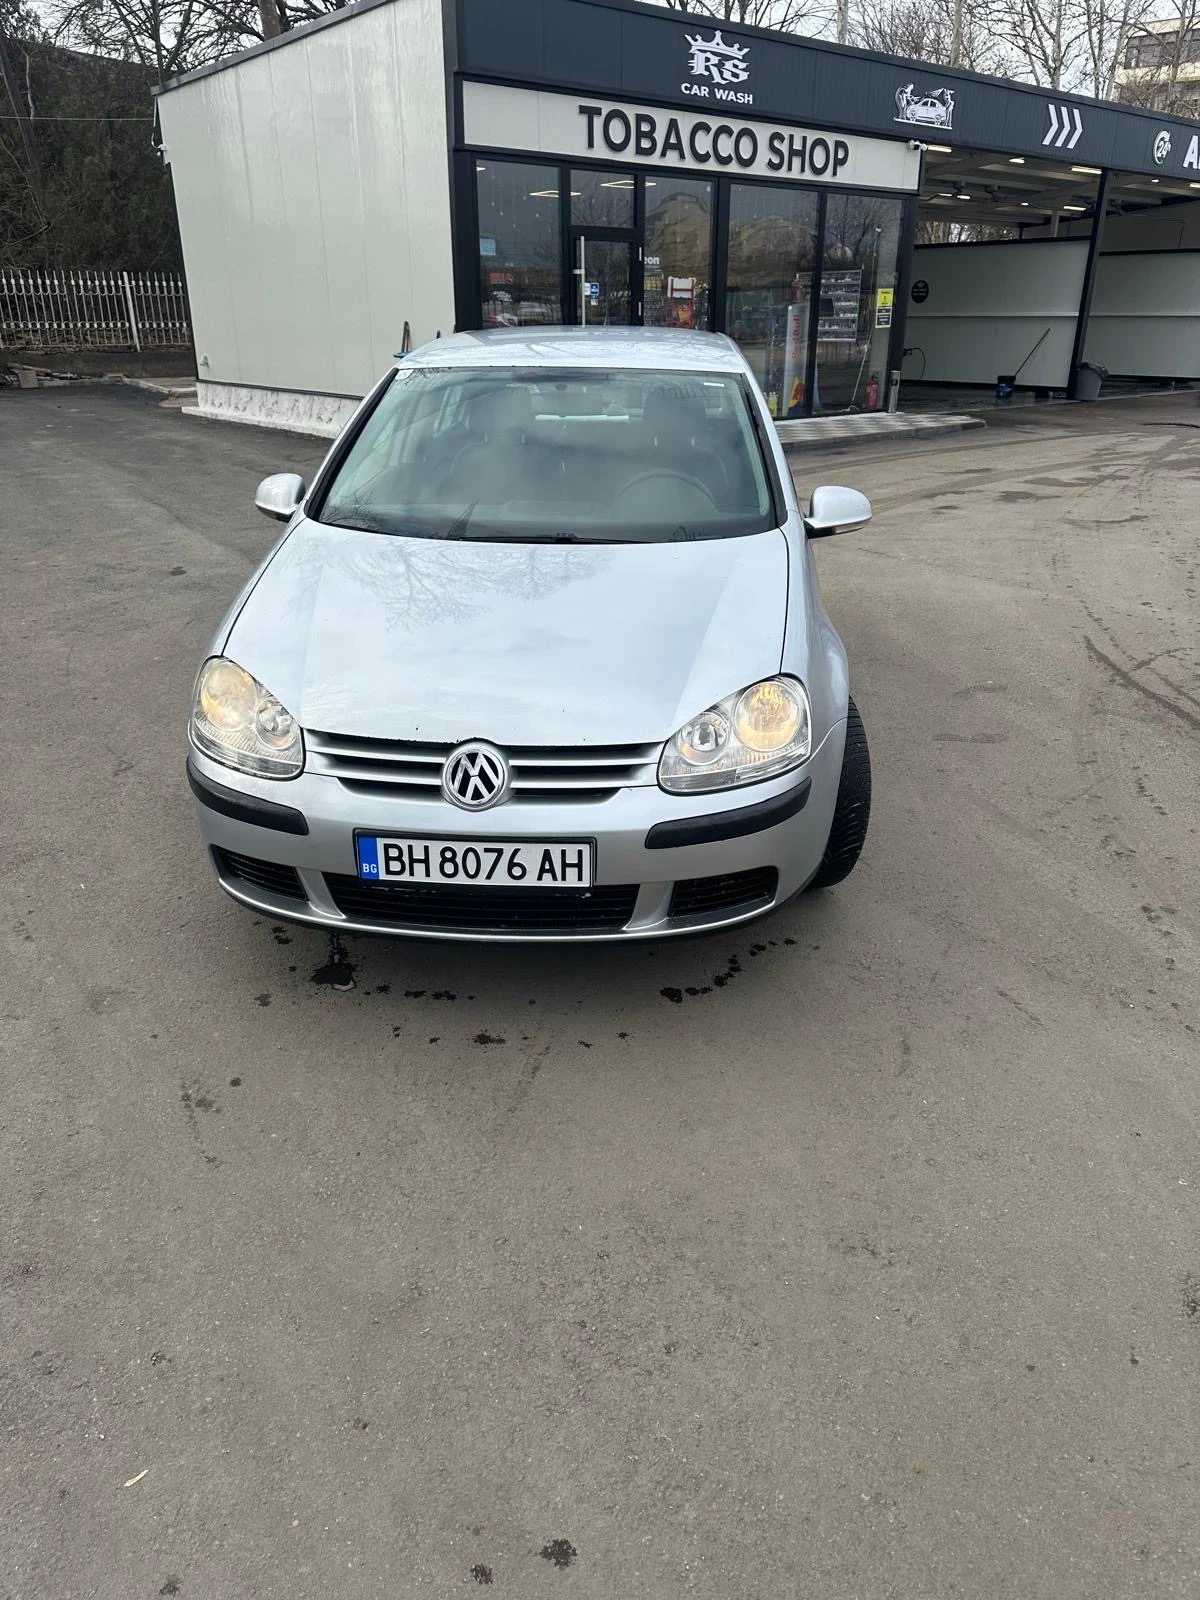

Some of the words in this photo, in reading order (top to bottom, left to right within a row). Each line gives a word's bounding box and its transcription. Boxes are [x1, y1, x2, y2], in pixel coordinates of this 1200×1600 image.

[687, 50, 750, 84] RS
[681, 83, 709, 97] CAR
[714, 88, 753, 104] WASH
[578, 104, 758, 167] TOBACCO
[767, 131, 849, 177] SHOP
[1182, 135, 1200, 169] A
[362, 862, 377, 873] BG
[383, 843, 431, 877] BH
[438, 846, 527, 880] 8076
[537, 848, 583, 882] AH
